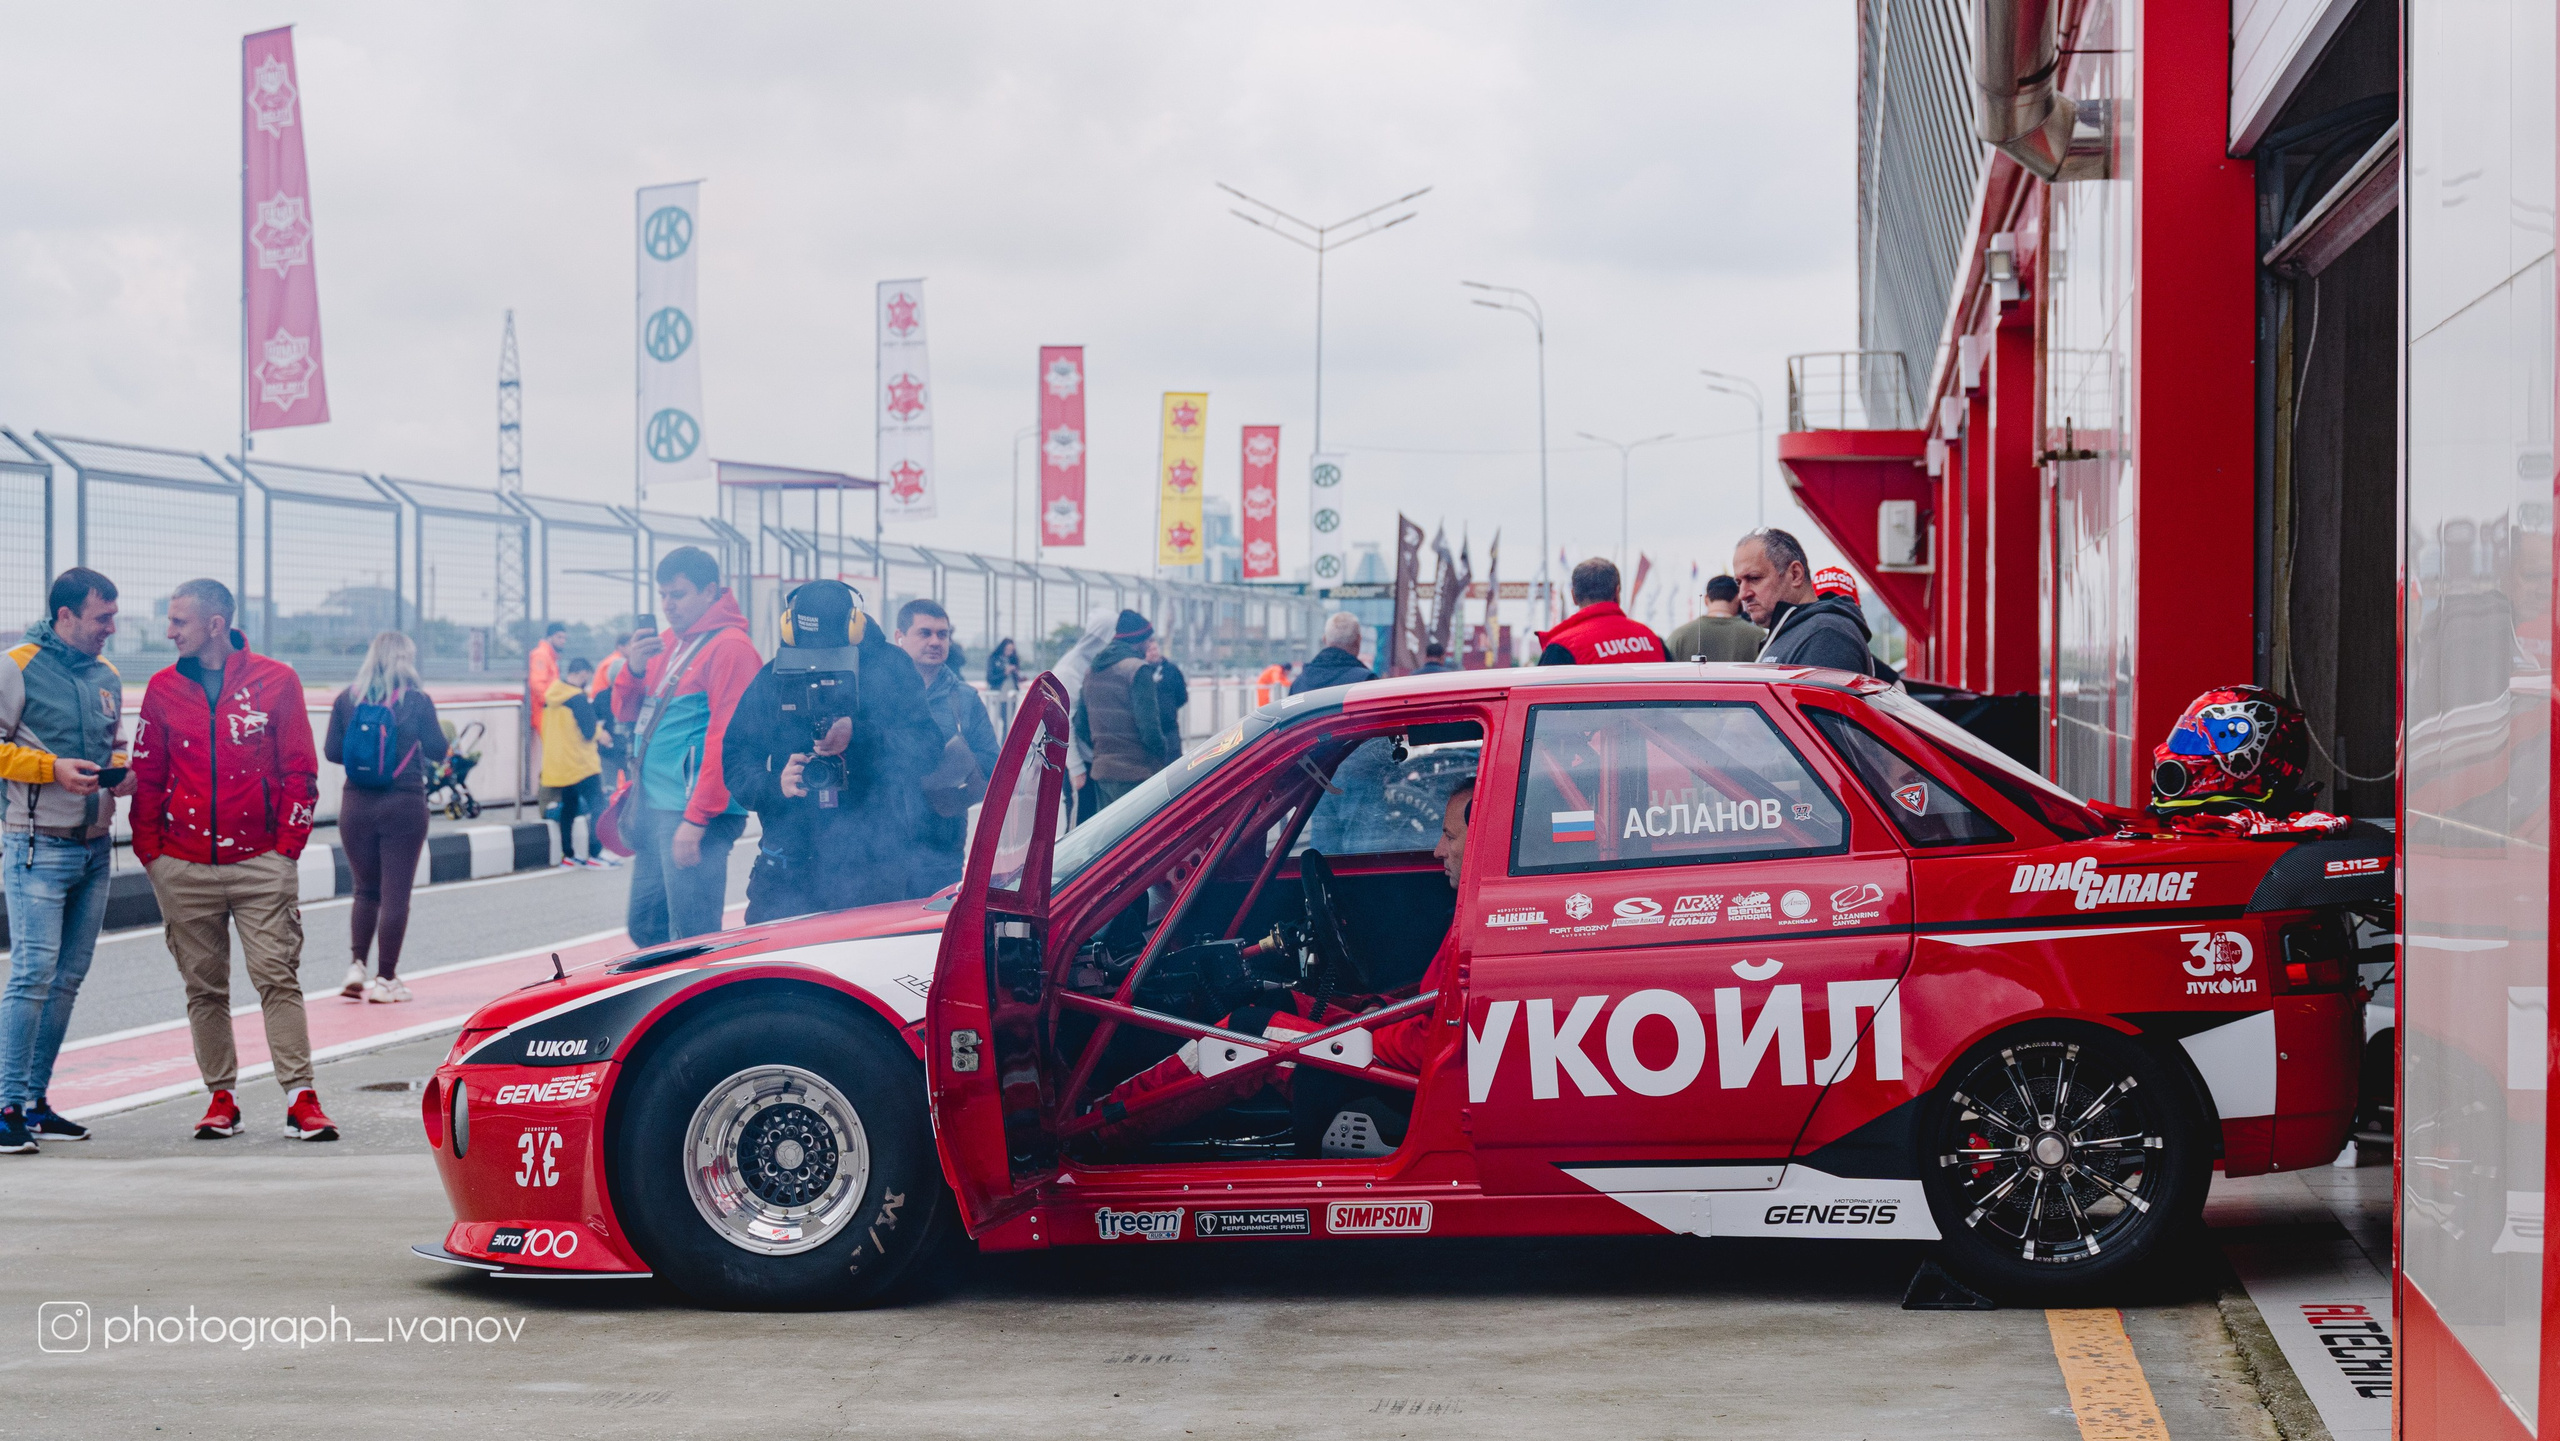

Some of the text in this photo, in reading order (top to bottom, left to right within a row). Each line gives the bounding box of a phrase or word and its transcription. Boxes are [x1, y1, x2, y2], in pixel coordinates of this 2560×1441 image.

[1814, 571, 1855, 588] LUKOIL
[1594, 636, 1654, 658] LUKOIL
[1623, 799, 1783, 839] АСЛАНОВ
[2326, 858, 2380, 872] 8.112
[2009, 856, 2098, 893] DRAG
[2074, 871, 2198, 910] GARAGE
[1487, 911, 1545, 924] БЫКОВО
[1668, 916, 1717, 927] КОЛЬЦО
[1778, 918, 1818, 926] КРАСНОДАР
[1832, 911, 1880, 921] KAZANRING
[1832, 919, 1860, 927] CANYON
[1549, 924, 1610, 935] FORT GROZNY
[2180, 931, 2254, 977] 30
[526, 1039, 588, 1057] LUKOIL
[496, 1078, 594, 1105] GENESIS
[1220, 1213, 1305, 1225] TIM MCAMIS
[1335, 1206, 1423, 1228] SIMPSON
[1764, 1205, 1898, 1225] GENESIS
[492, 1228, 578, 1258] ЭКТО 100
